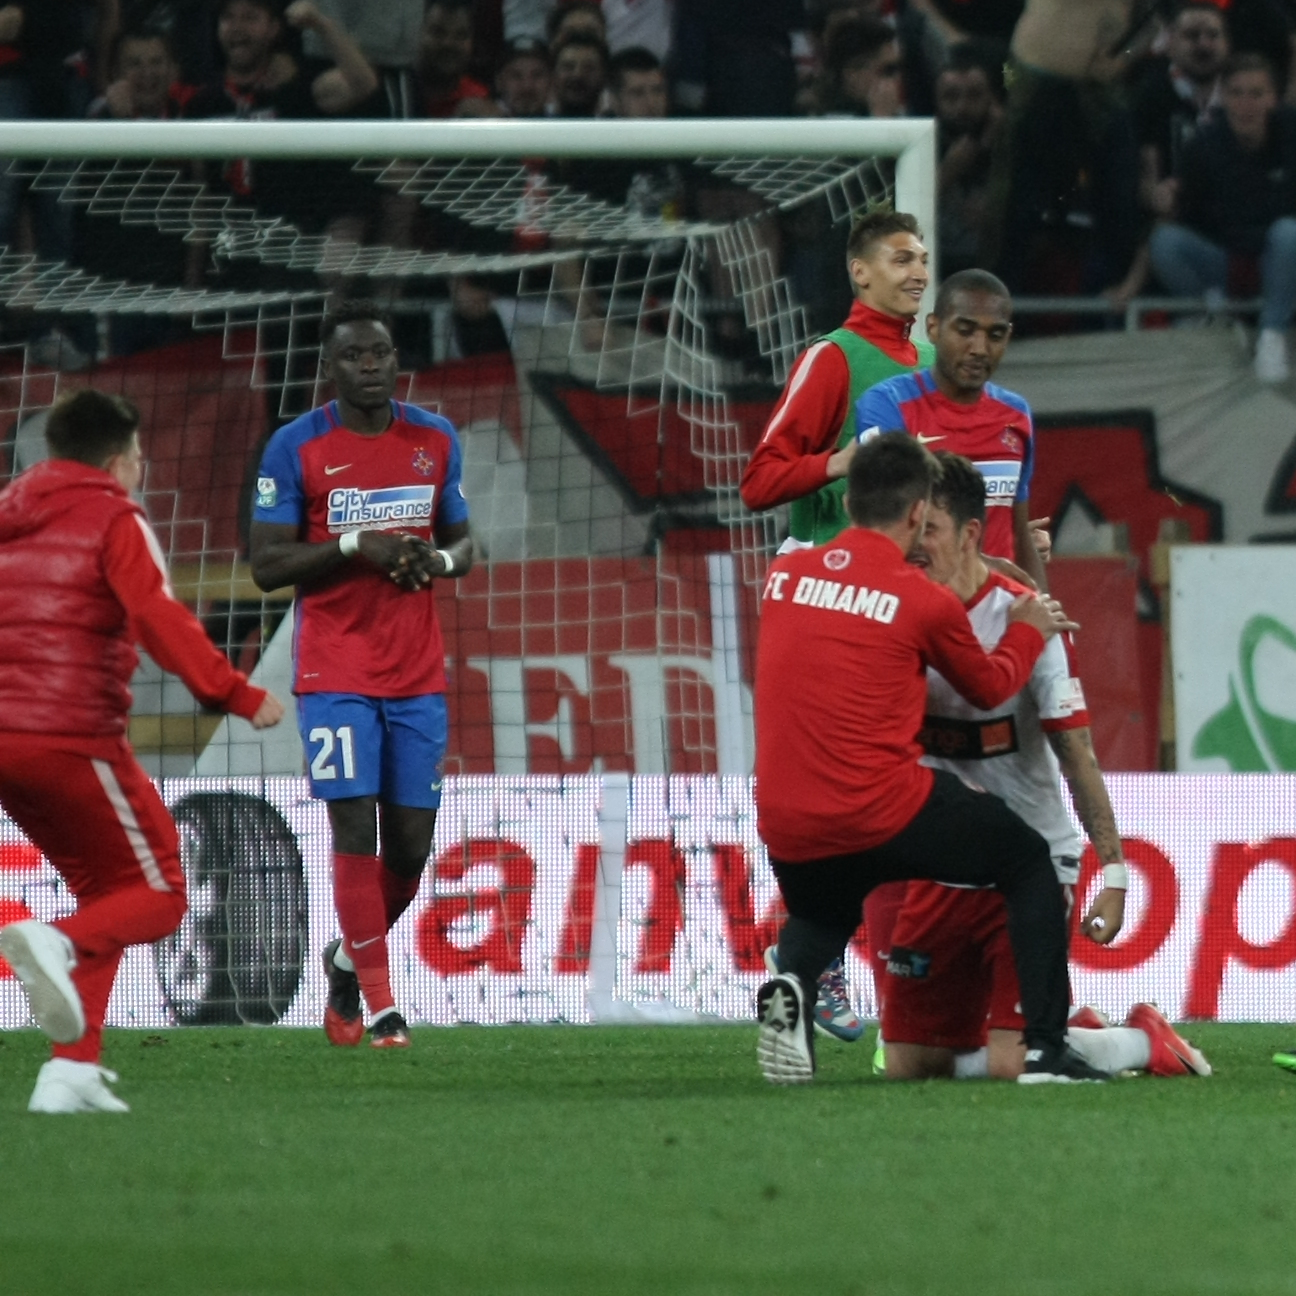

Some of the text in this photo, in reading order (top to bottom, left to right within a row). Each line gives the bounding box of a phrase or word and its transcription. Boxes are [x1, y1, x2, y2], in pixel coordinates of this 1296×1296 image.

[330, 488, 370, 509] City
[343, 502, 432, 522] Insurance
[762, 570, 900, 625] FC DINAMO
[308, 726, 355, 781] 21
